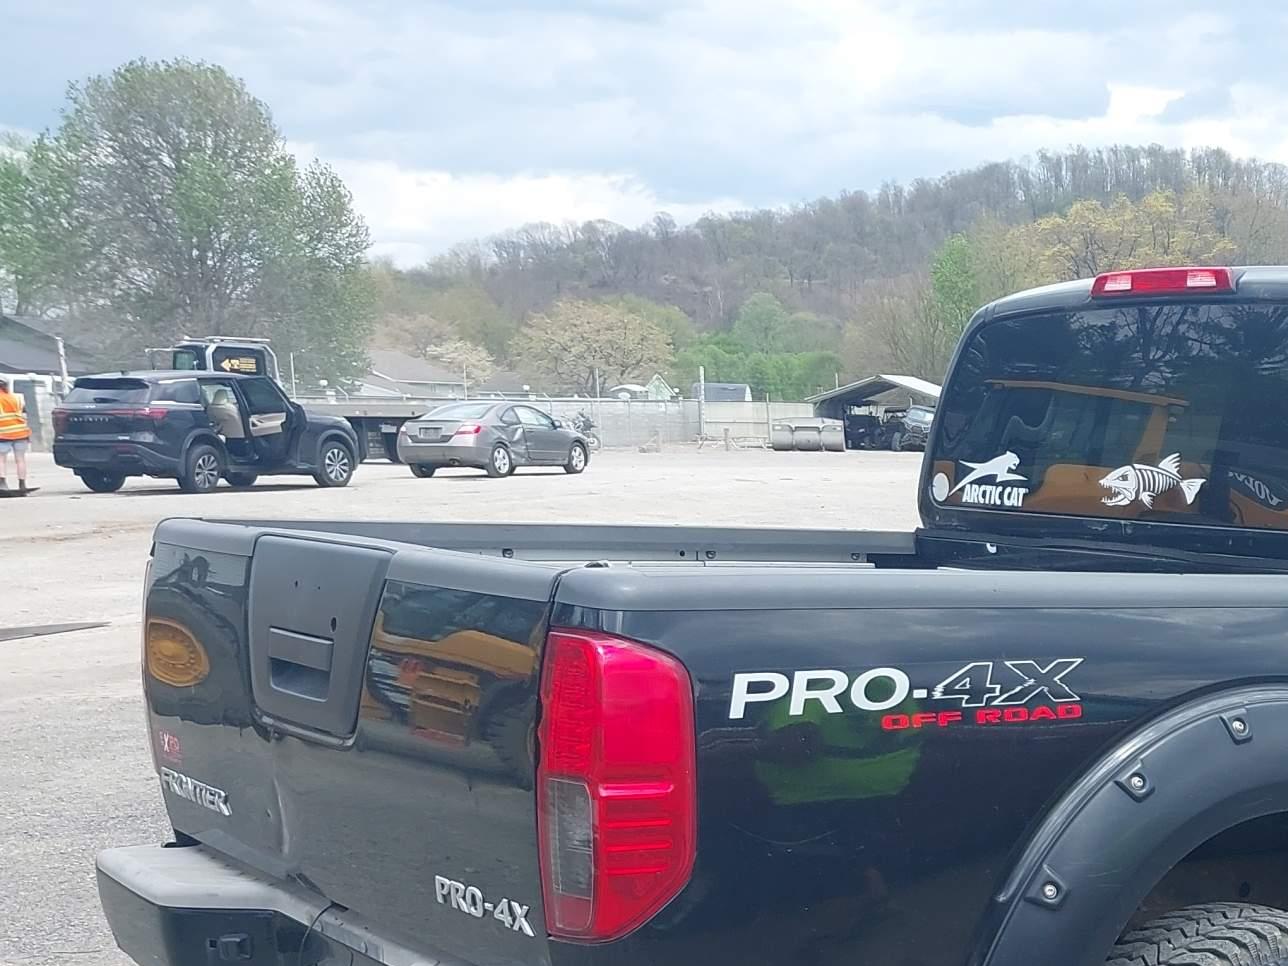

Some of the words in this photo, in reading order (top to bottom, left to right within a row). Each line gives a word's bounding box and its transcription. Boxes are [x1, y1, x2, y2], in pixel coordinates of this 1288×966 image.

[962, 484, 1003, 505] ARCTIC
[1003, 486, 1026, 507] CAT
[729, 658, 1083, 719] PRO-4X
[881, 711, 963, 731] OFF
[976, 703, 1083, 725] ROAD
[161, 766, 232, 816] FRONTIER
[434, 874, 536, 937] PRO-4X
